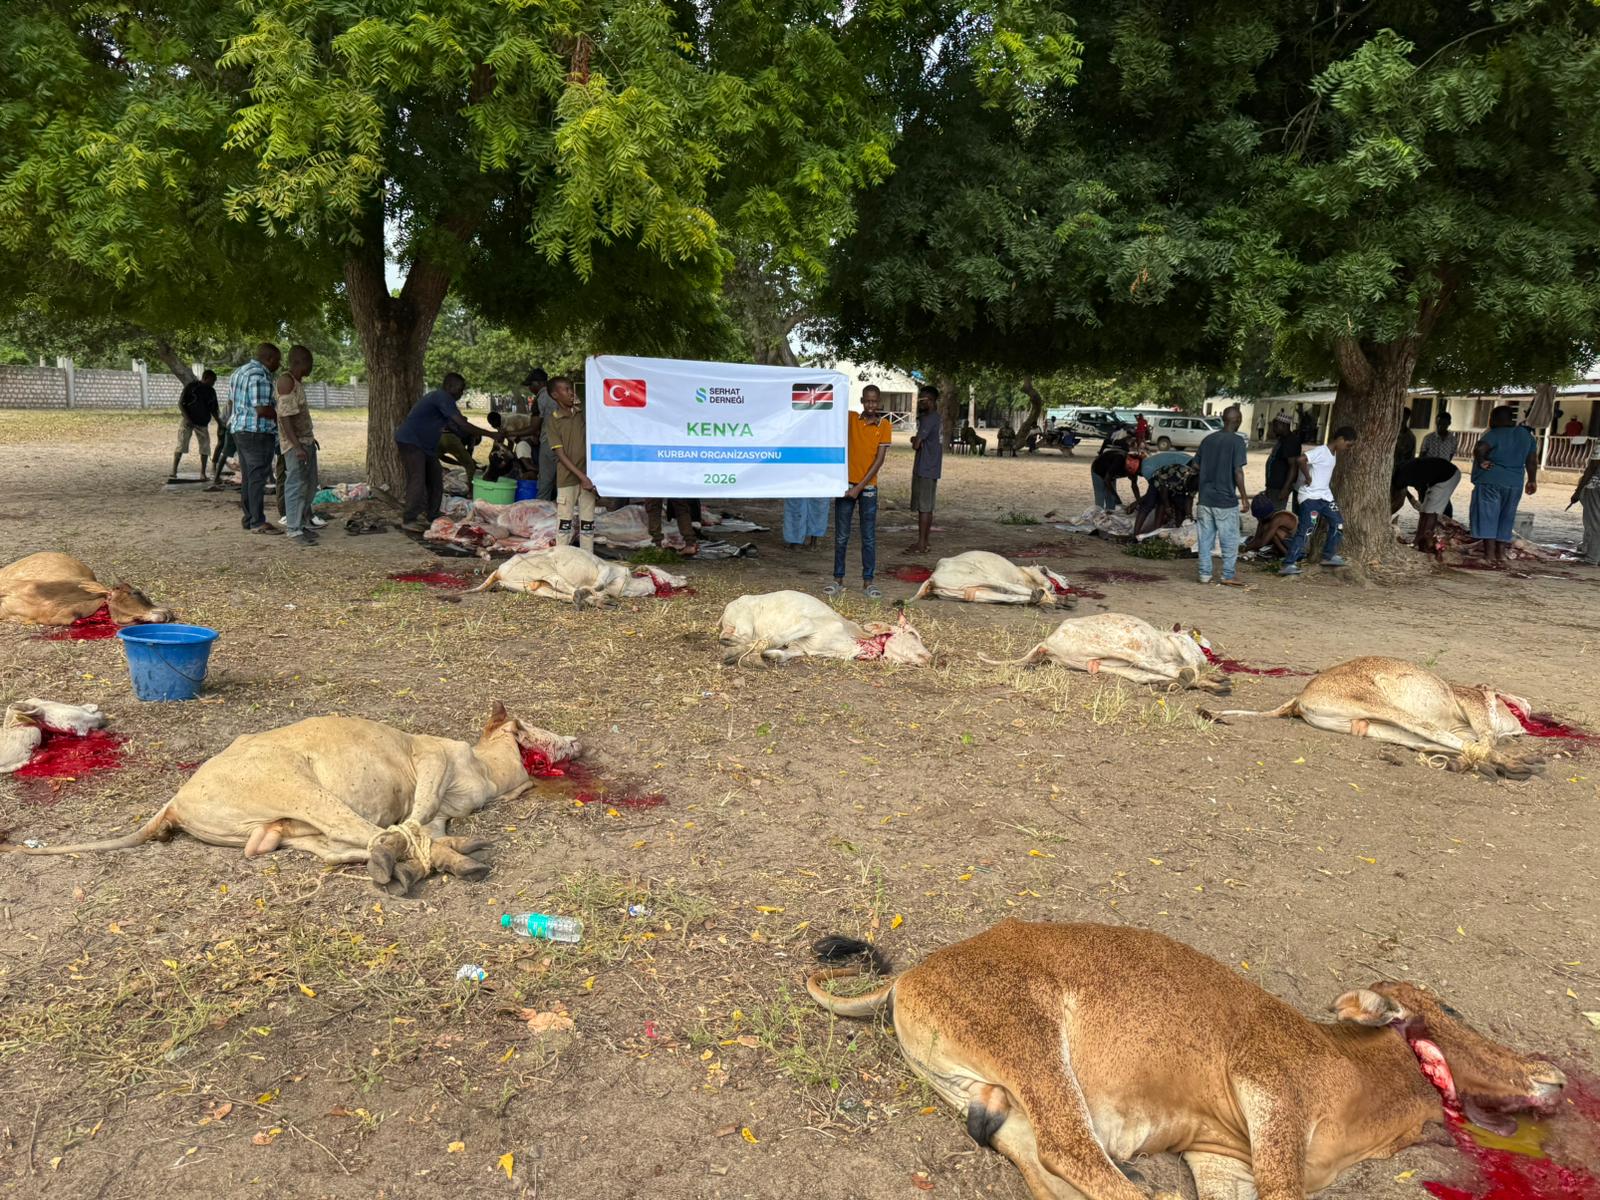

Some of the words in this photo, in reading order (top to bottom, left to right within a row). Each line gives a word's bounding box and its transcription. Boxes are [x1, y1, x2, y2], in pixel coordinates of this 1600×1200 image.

[709, 387, 741, 395] SERHAT
[687, 422, 753, 437] KENYA
[657, 450, 698, 459] KURBAN
[699, 449, 782, 460] ORGANİZASYONU
[703, 474, 737, 484] 2026
